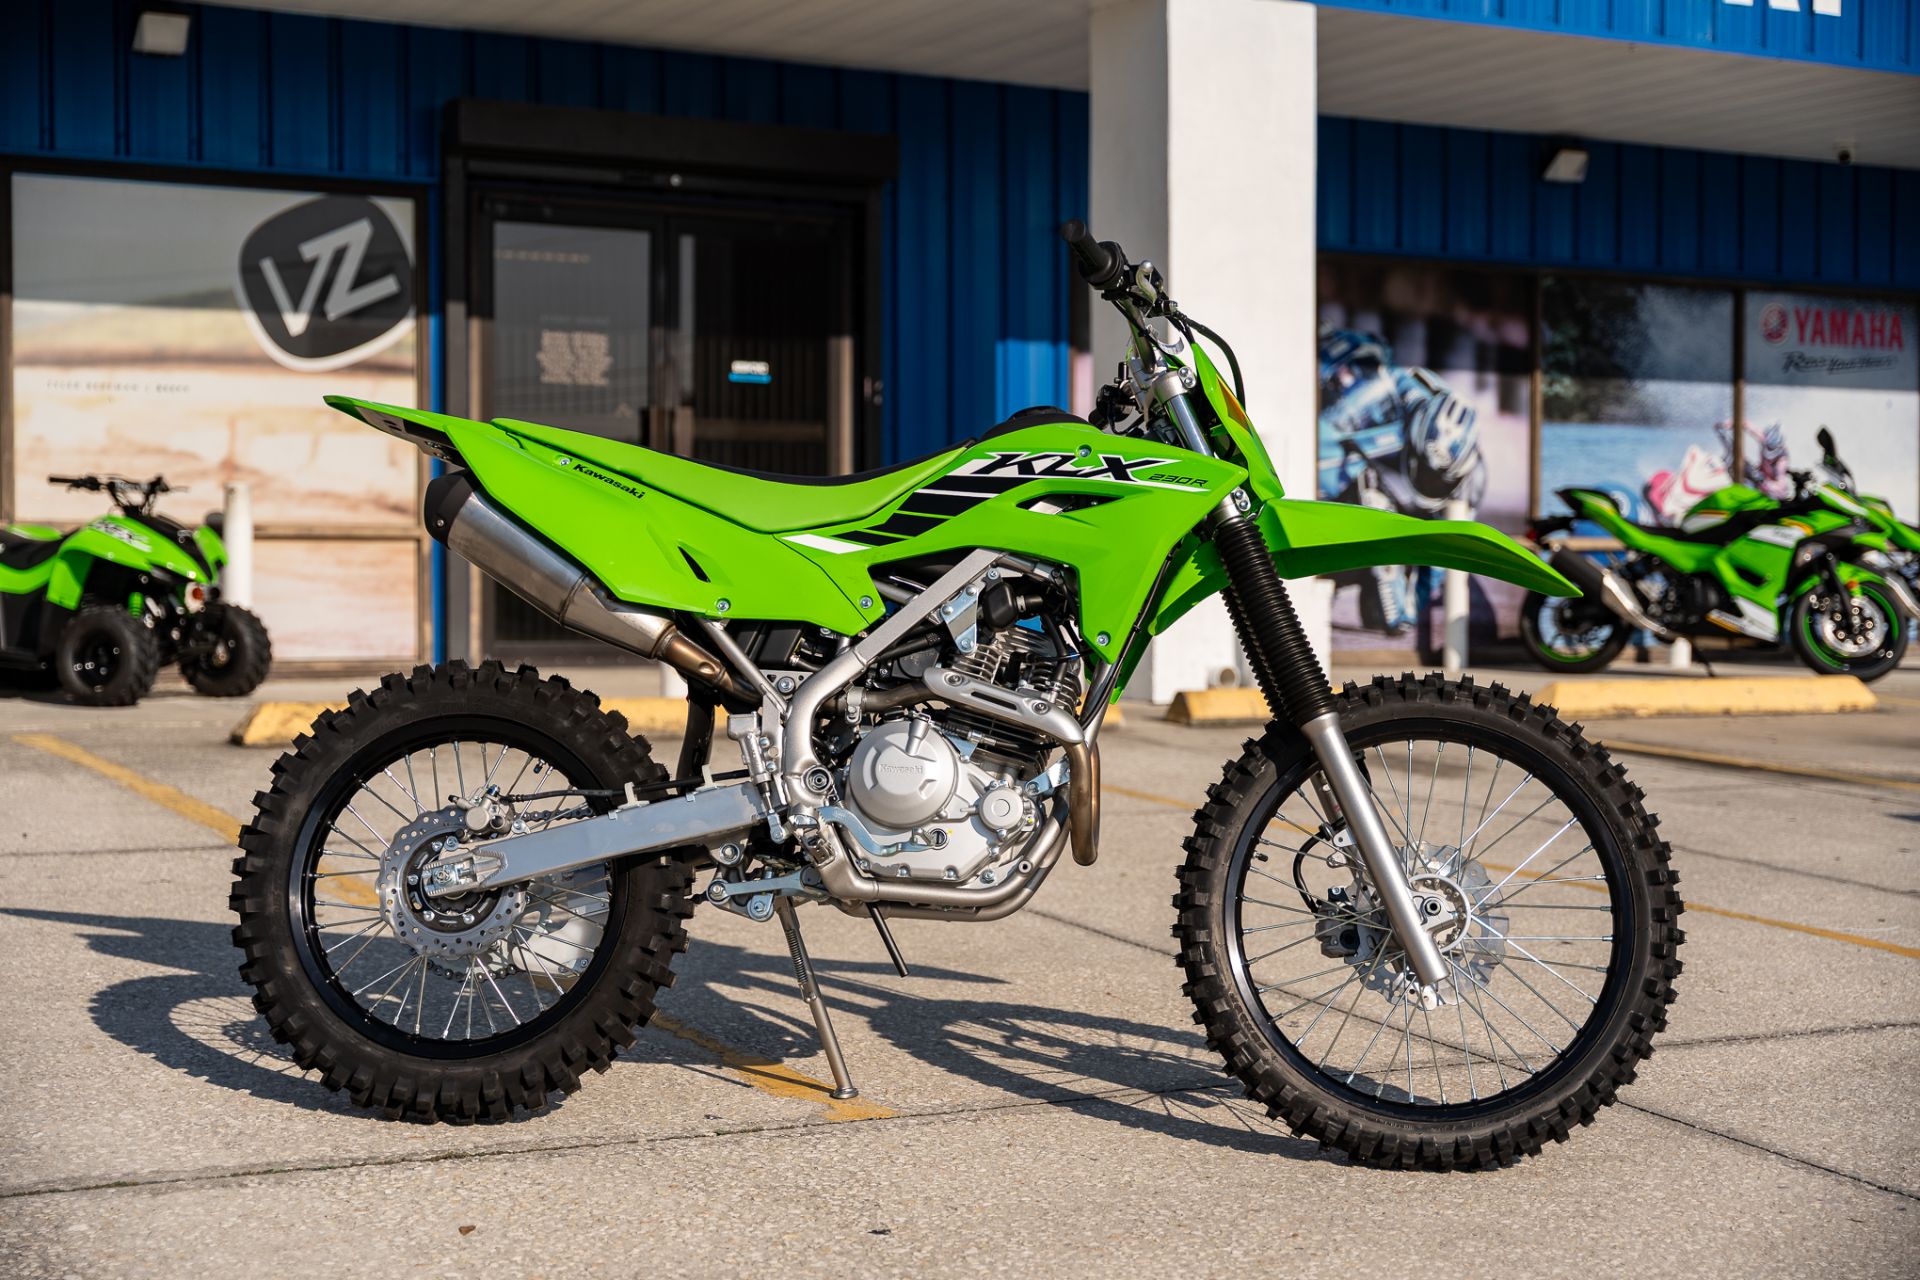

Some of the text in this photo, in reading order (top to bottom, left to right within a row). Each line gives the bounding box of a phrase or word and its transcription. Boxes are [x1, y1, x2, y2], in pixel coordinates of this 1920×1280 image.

[1793, 305, 1904, 351] YAMAHA
[573, 463, 645, 499] Kawasaki
[970, 452, 1209, 487] KLX 230R
